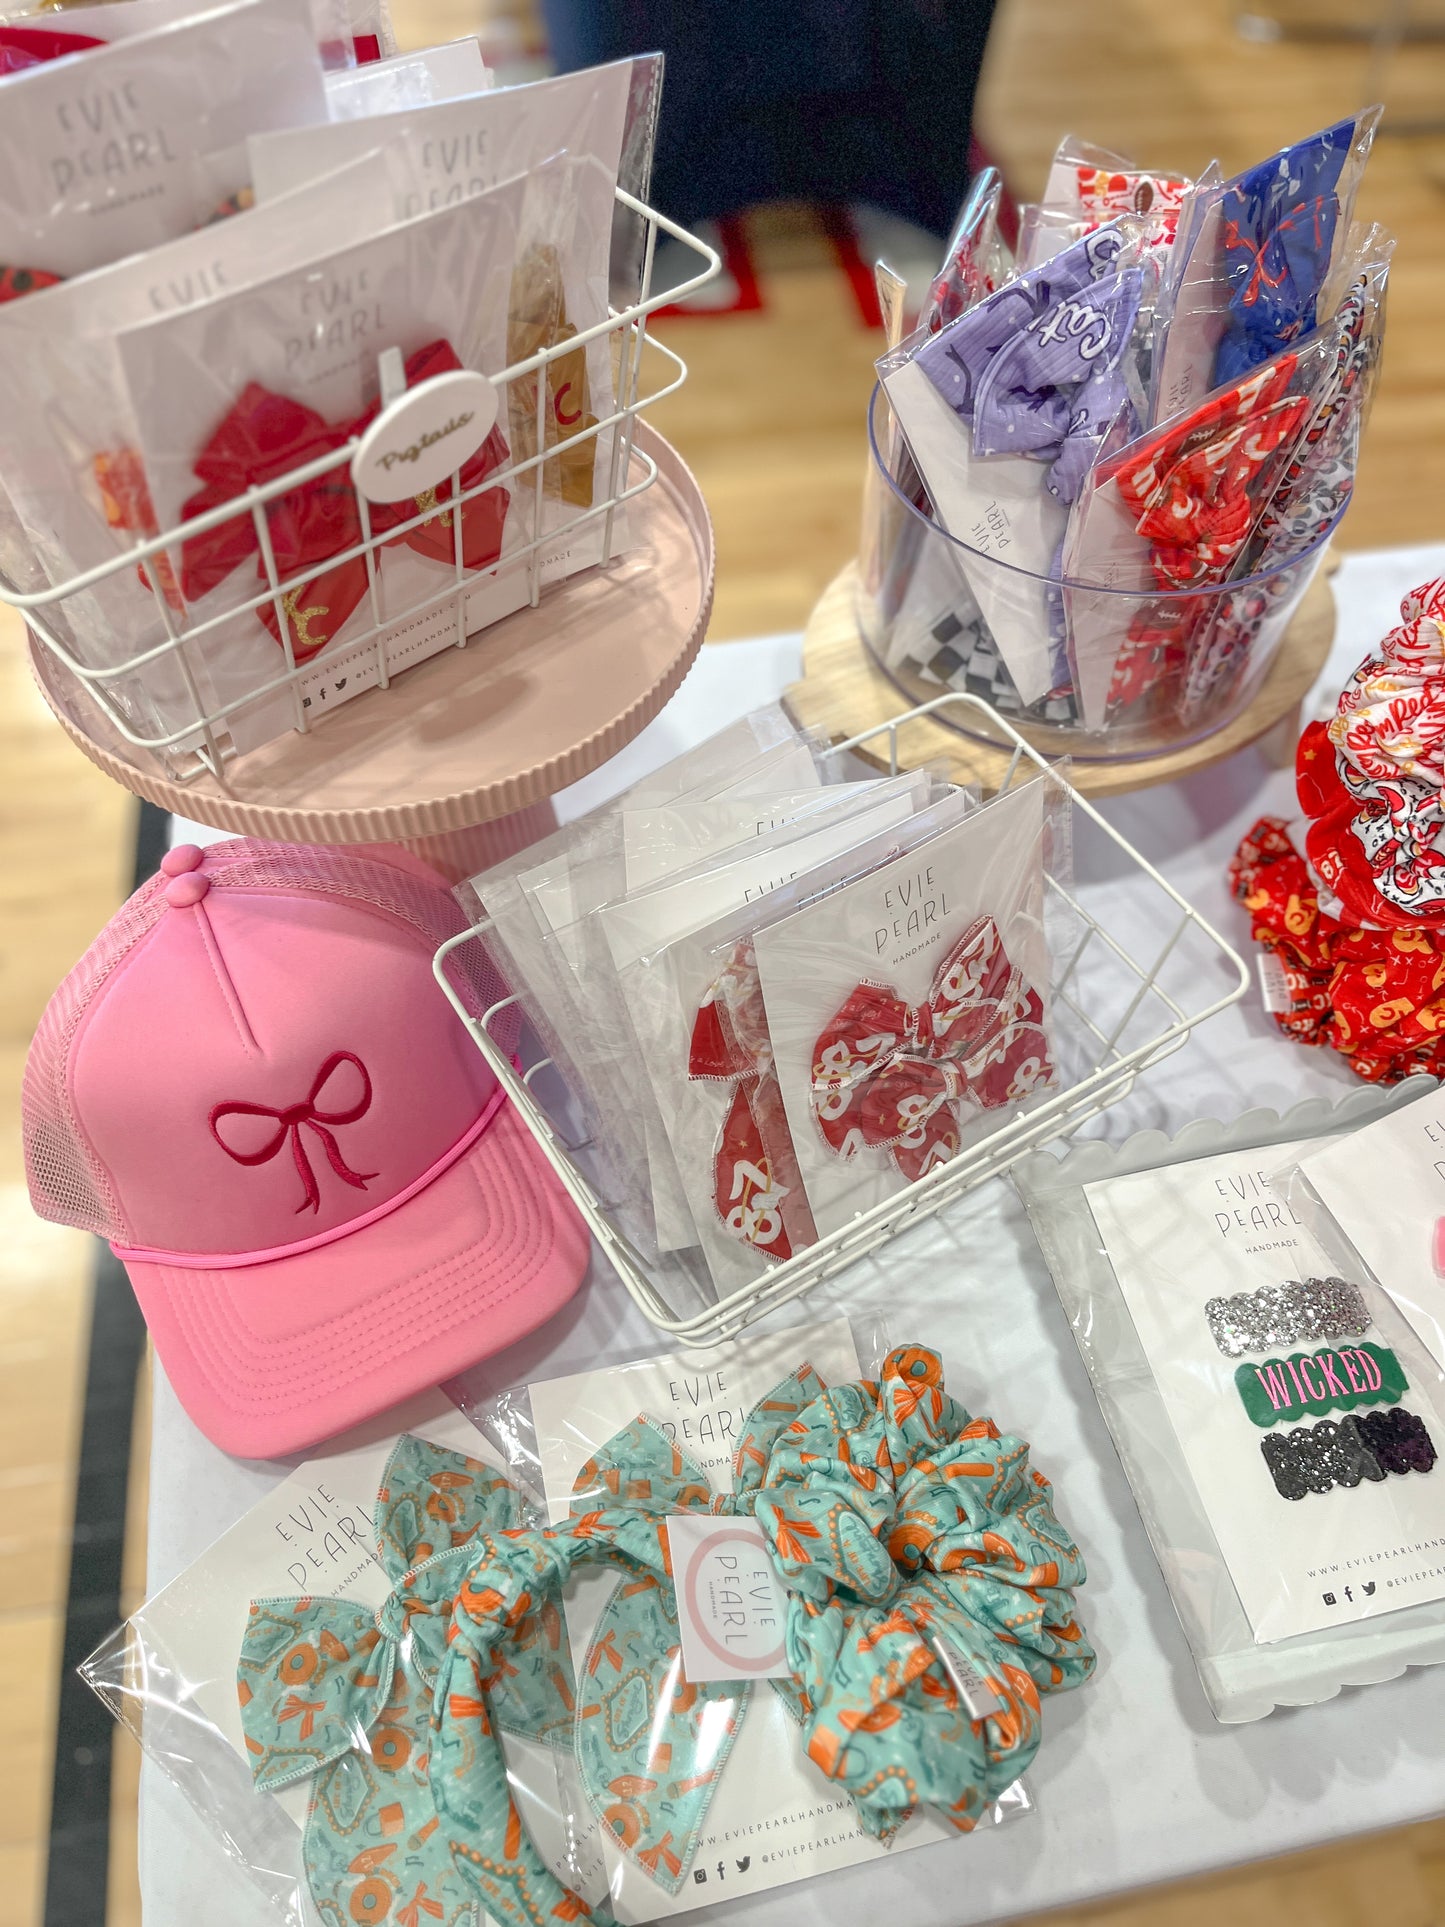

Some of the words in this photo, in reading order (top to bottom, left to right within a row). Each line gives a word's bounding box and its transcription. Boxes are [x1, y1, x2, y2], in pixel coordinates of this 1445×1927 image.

[57, 80, 138, 133] EVIE
[51, 126, 176, 196] PEARL
[422, 129, 492, 176] EVIE
[148, 261, 229, 313] EVIE
[284, 304, 387, 374] PEARL
[984, 500, 1012, 549] PEARL
[884, 866, 935, 915] EVIE
[874, 893, 952, 955] PEARL
[893, 932, 942, 966] HANDMADE
[1215, 1170, 1273, 1204] EVIE
[1214, 1202, 1303, 1238] PEARL
[1244, 1238, 1300, 1255] HANDMADE
[668, 1371, 728, 1410] EVIE
[1253, 1348, 1383, 1411] WICKED
[275, 1483, 338, 1547] EVIE
[330, 1552, 379, 1598] HANDMAD
[745, 1571, 776, 1627] EVIE
[708, 1581, 718, 1619] HANDMADE
[713, 1556, 749, 1645] PEARL
[948, 1651, 979, 1698] PEARL
